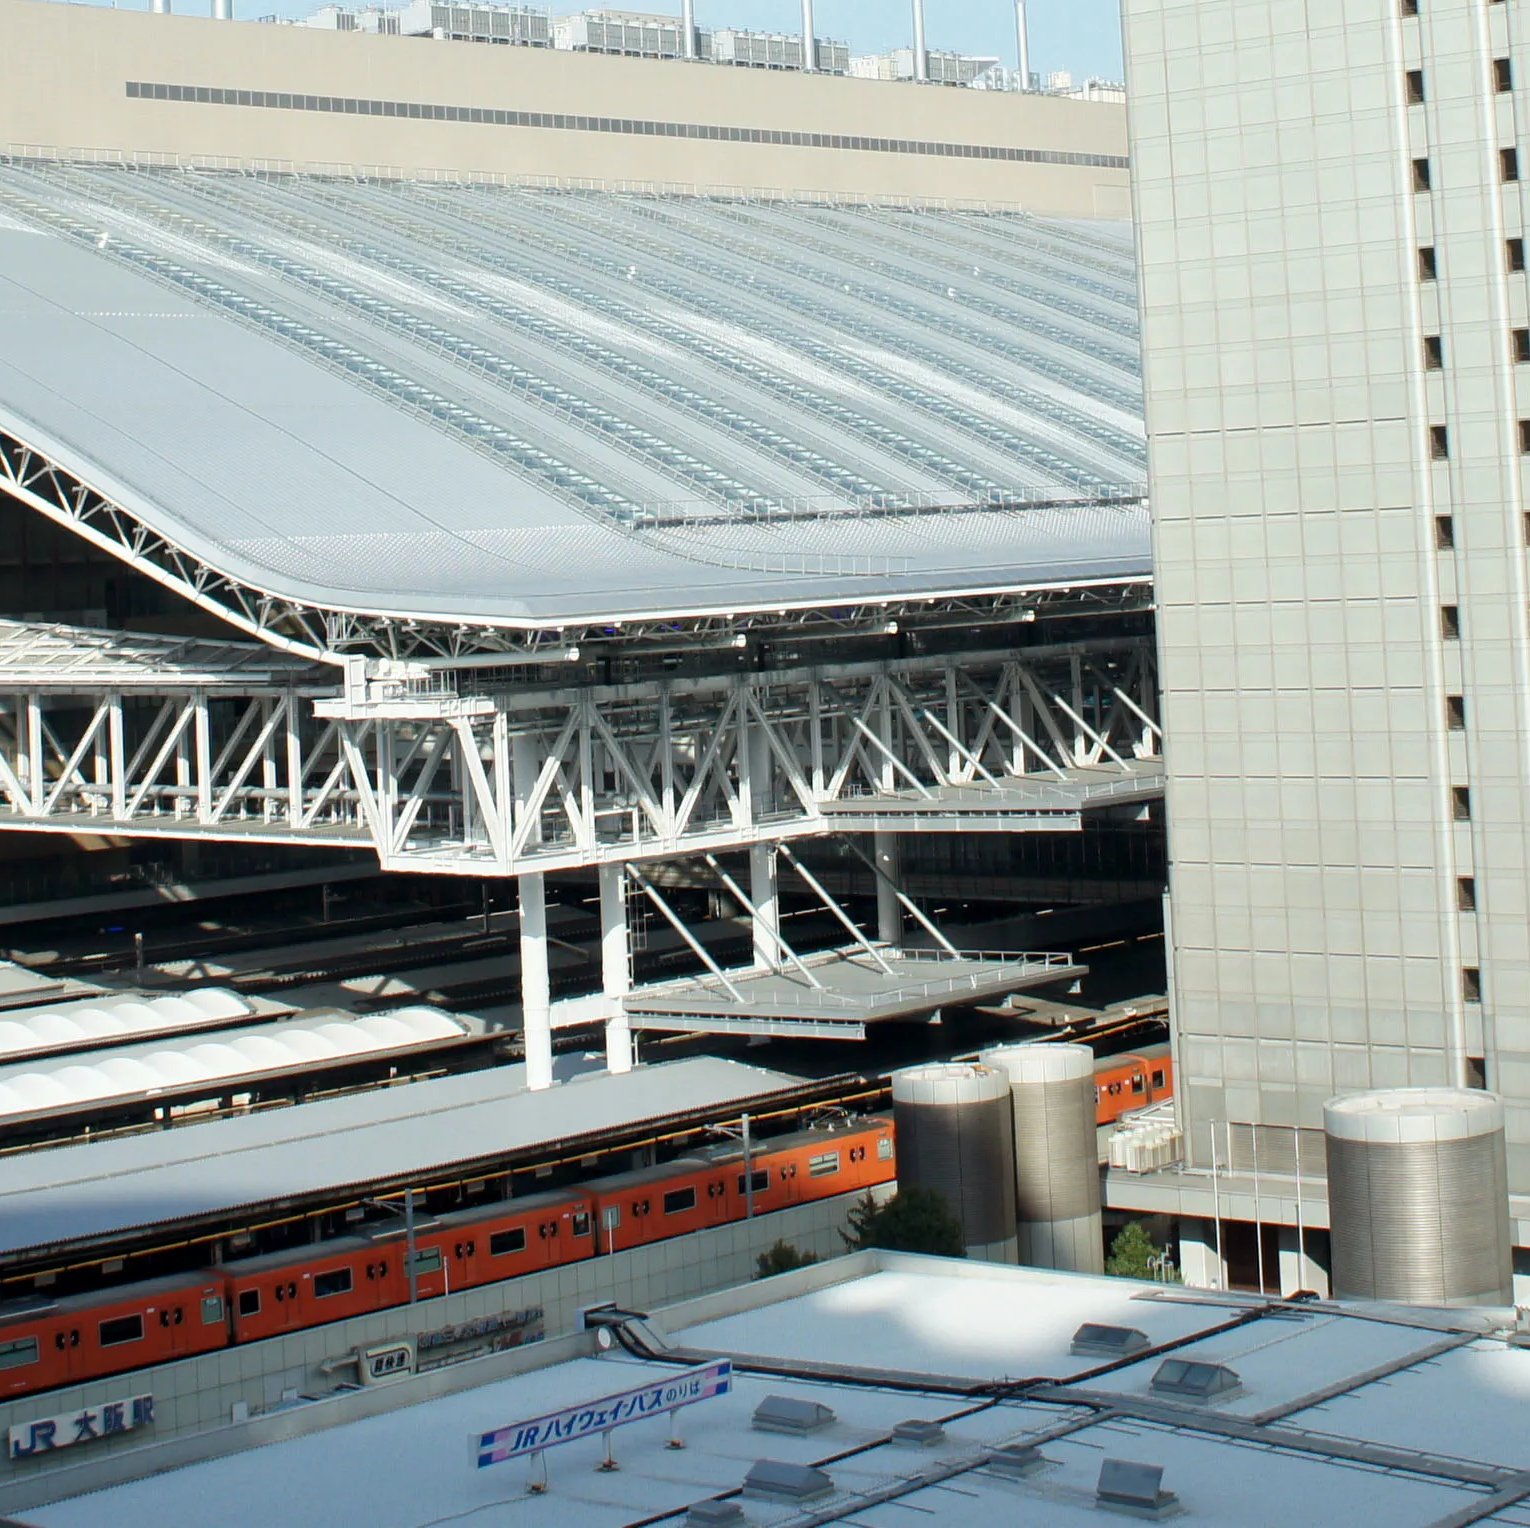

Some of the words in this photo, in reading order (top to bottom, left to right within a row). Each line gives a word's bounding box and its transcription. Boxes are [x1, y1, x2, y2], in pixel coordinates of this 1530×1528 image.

[13, 1419, 57, 1457] JR
[75, 1394, 155, 1442] 大阪駅
